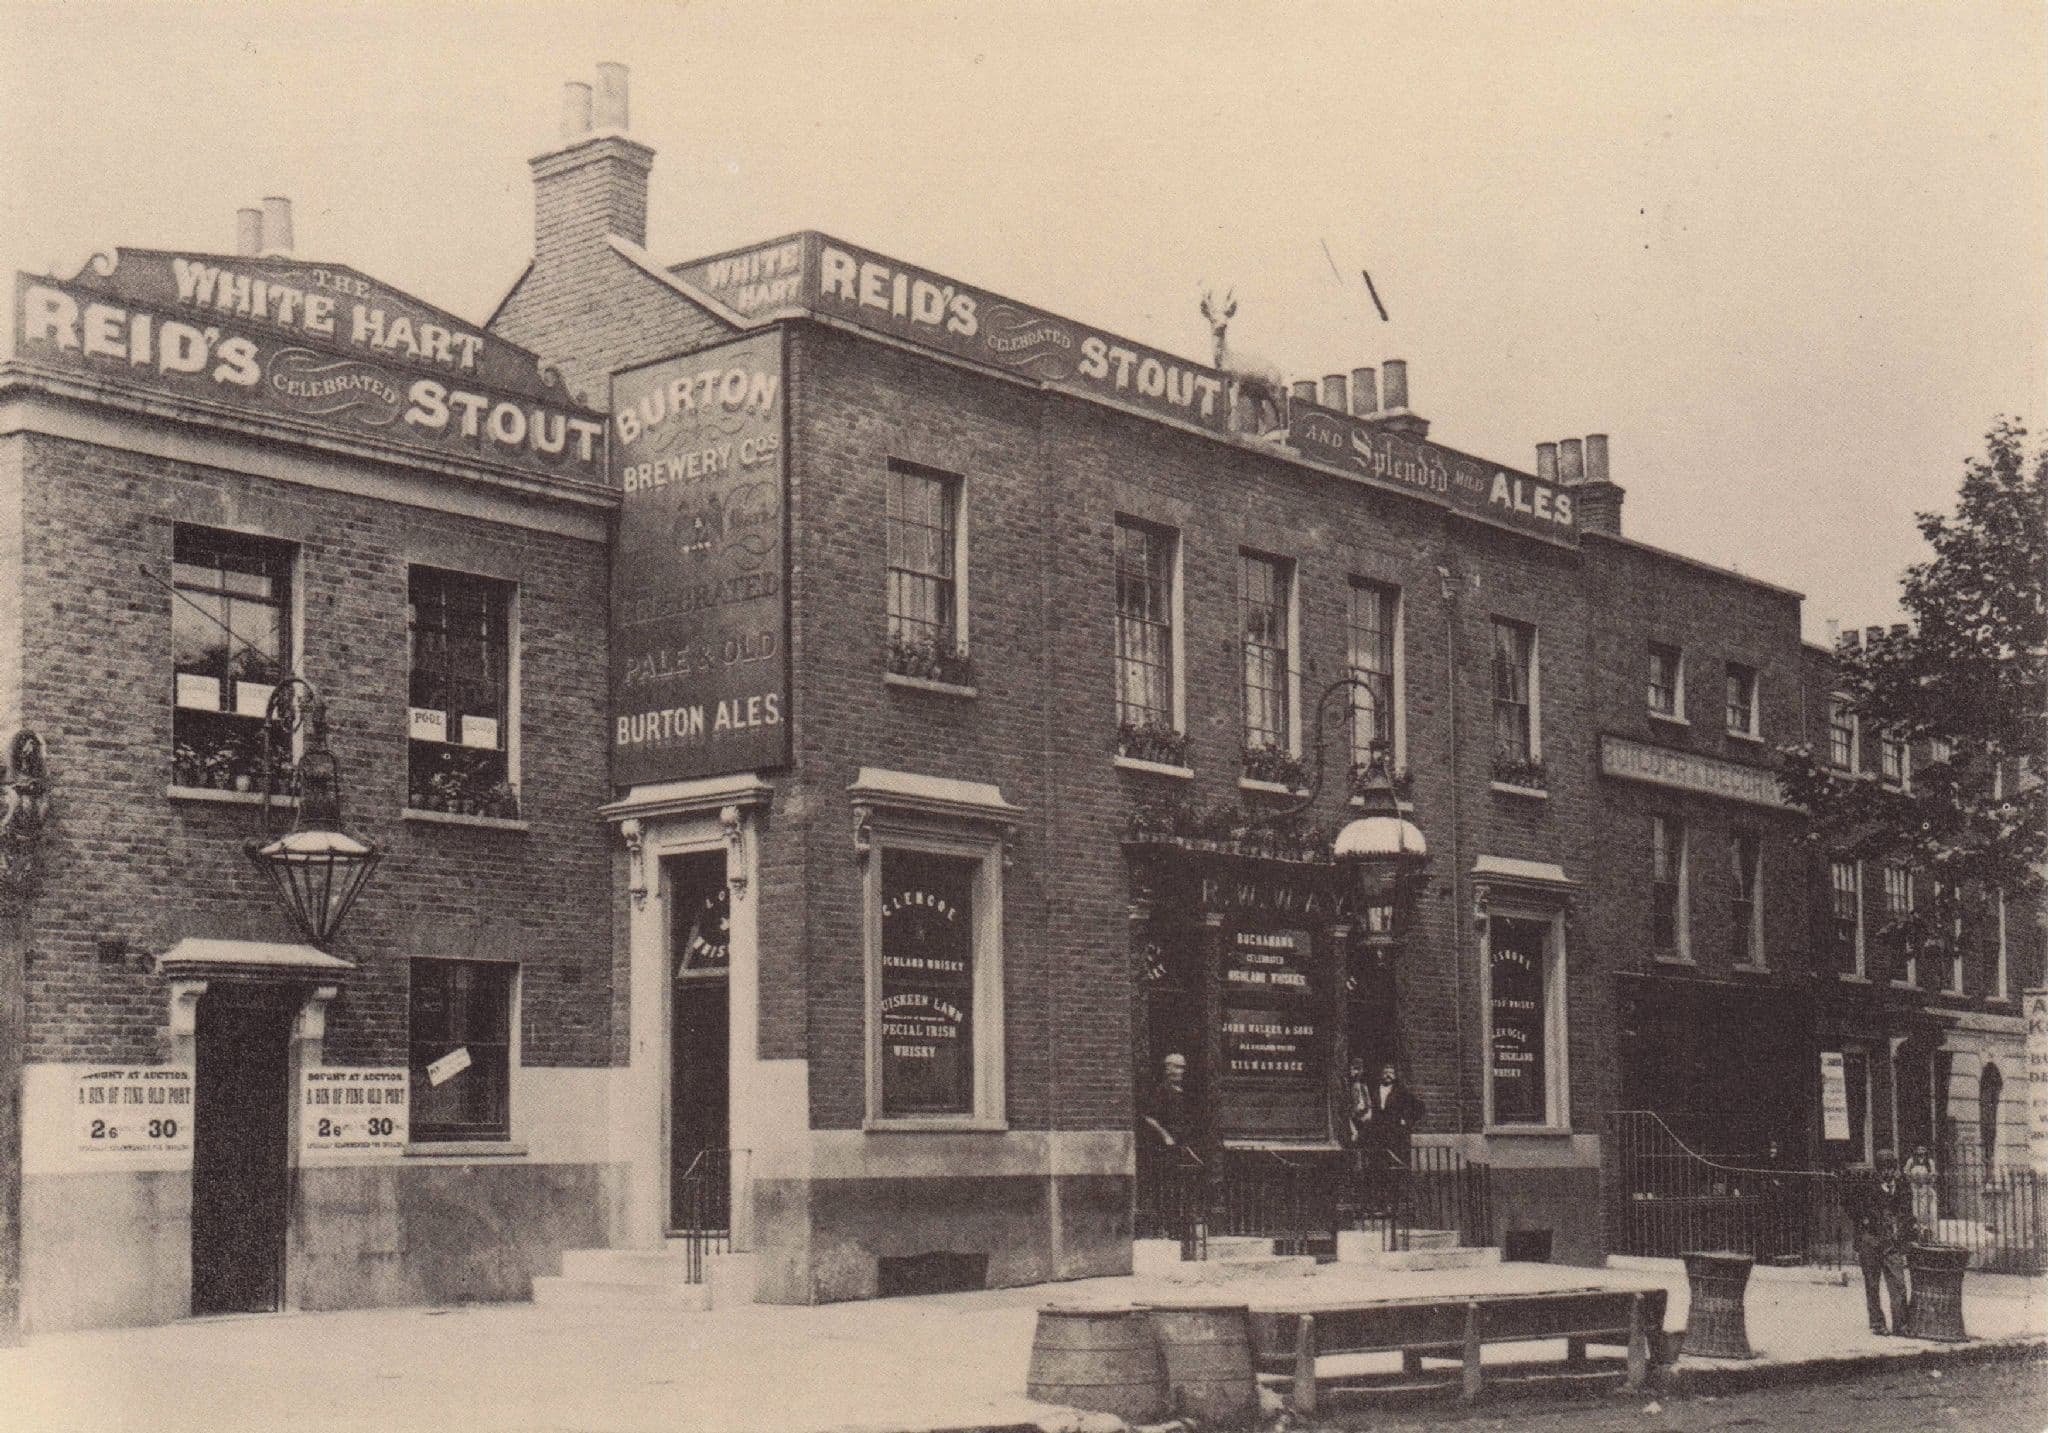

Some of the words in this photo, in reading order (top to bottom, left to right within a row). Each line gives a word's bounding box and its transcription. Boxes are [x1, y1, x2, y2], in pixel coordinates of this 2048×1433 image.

[311, 268, 374, 297] THE
[172, 257, 336, 335] WHITE
[350, 304, 484, 370] HART
[24, 285, 262, 387] REID'S
[272, 373, 396, 404] CELEBRATED
[404, 378, 602, 462] STOUT
[820, 246, 979, 336] REID'S
[986, 329, 1071, 352] CELEBRATED
[1078, 336, 1221, 418] STOUT
[1305, 425, 1343, 449] AND
[1488, 471, 1573, 526] ALES
[616, 367, 778, 446] BURTON
[623, 443, 733, 493] BREWERY
[719, 631, 778, 666] OLD
[617, 705, 704, 746] BURTON
[882, 1023, 923, 1036] PECIAL
[926, 1025, 957, 1038] IRISH
[1222, 1022, 1246, 1035] JOHN
[1248, 1024, 1283, 1037] WALKER
[893, 1045, 936, 1058] WHISKY
[127, 1071, 140, 1080] AT
[143, 1071, 188, 1080] AUCTION
[349, 1073, 361, 1081] AT
[363, 1073, 402, 1081] AUCTION
[123, 1086, 144, 1104] FINE
[148, 1086, 165, 1104] OLD
[168, 1086, 191, 1104] PORT
